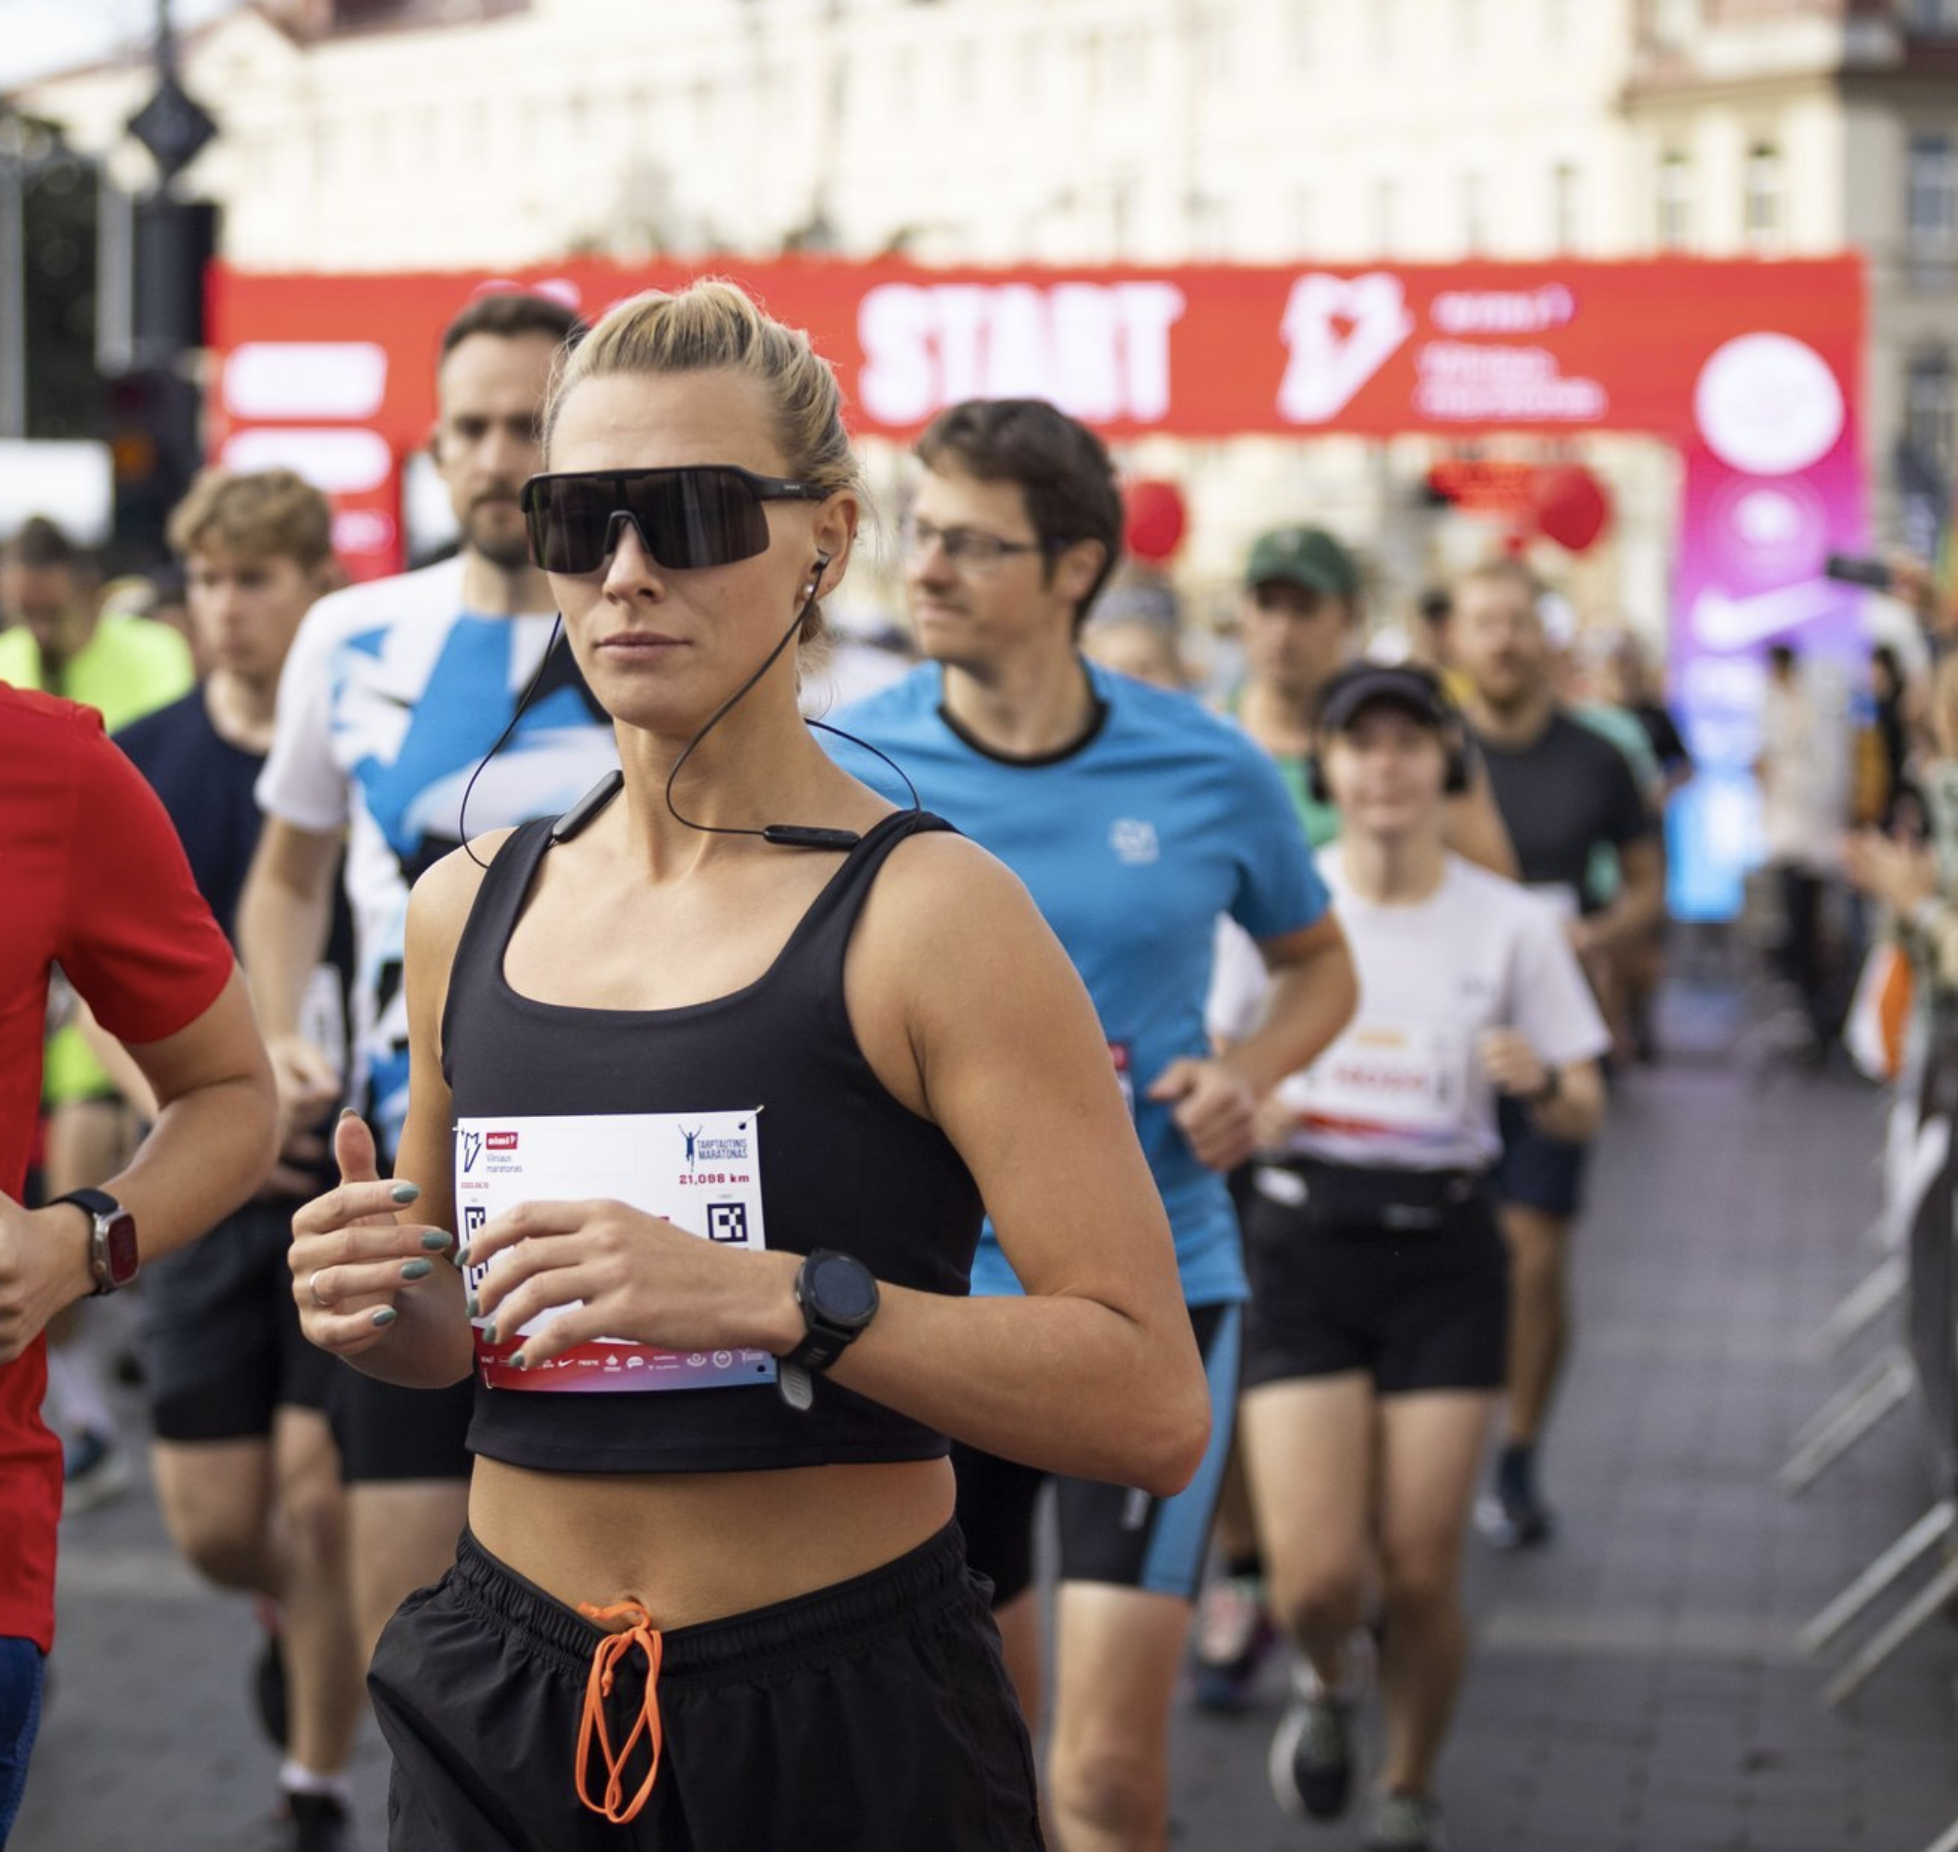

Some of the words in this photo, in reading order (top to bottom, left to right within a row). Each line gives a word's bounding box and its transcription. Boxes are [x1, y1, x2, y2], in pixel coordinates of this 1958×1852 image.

[858, 281, 1186, 425] START
[697, 1138, 748, 1150] TARPTAUTINIS
[698, 1148, 749, 1160] MARATONAS
[730, 1173, 750, 1183] km
